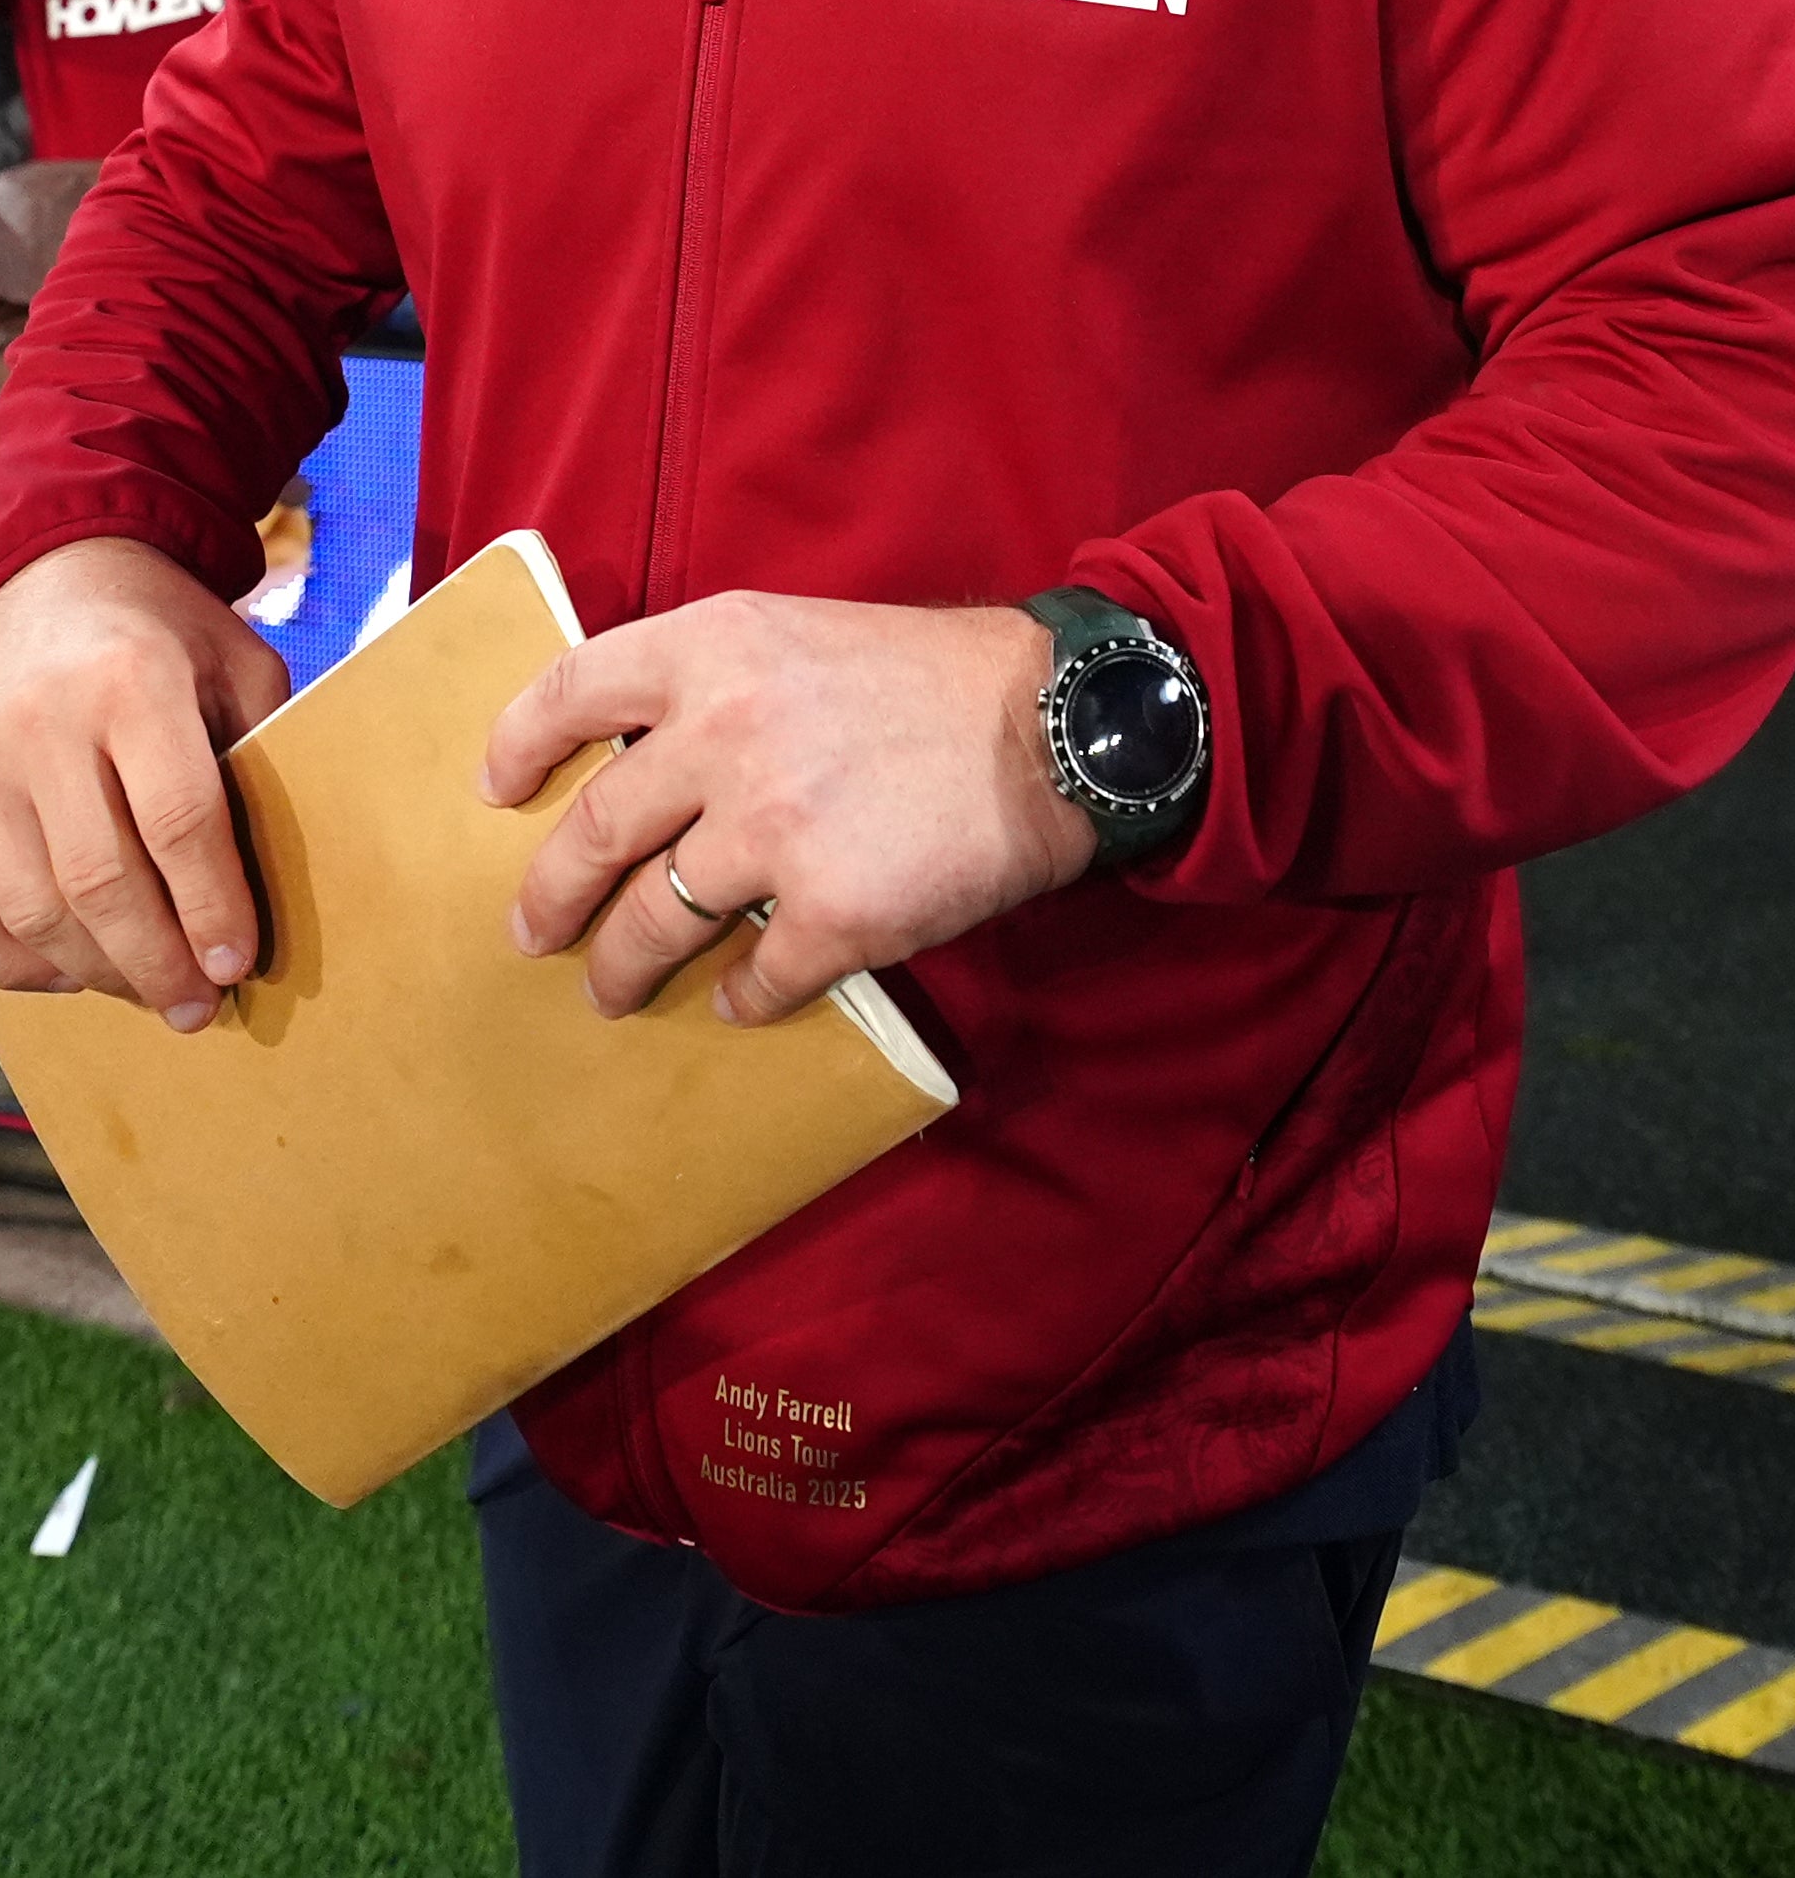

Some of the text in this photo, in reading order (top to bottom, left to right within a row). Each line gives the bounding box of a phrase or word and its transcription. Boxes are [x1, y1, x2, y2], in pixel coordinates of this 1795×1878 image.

[714, 1374, 852, 1433] Andy Farrell
[723, 1417, 840, 1471] Lions Tour
[700, 1453, 867, 1511] Australia 2025
